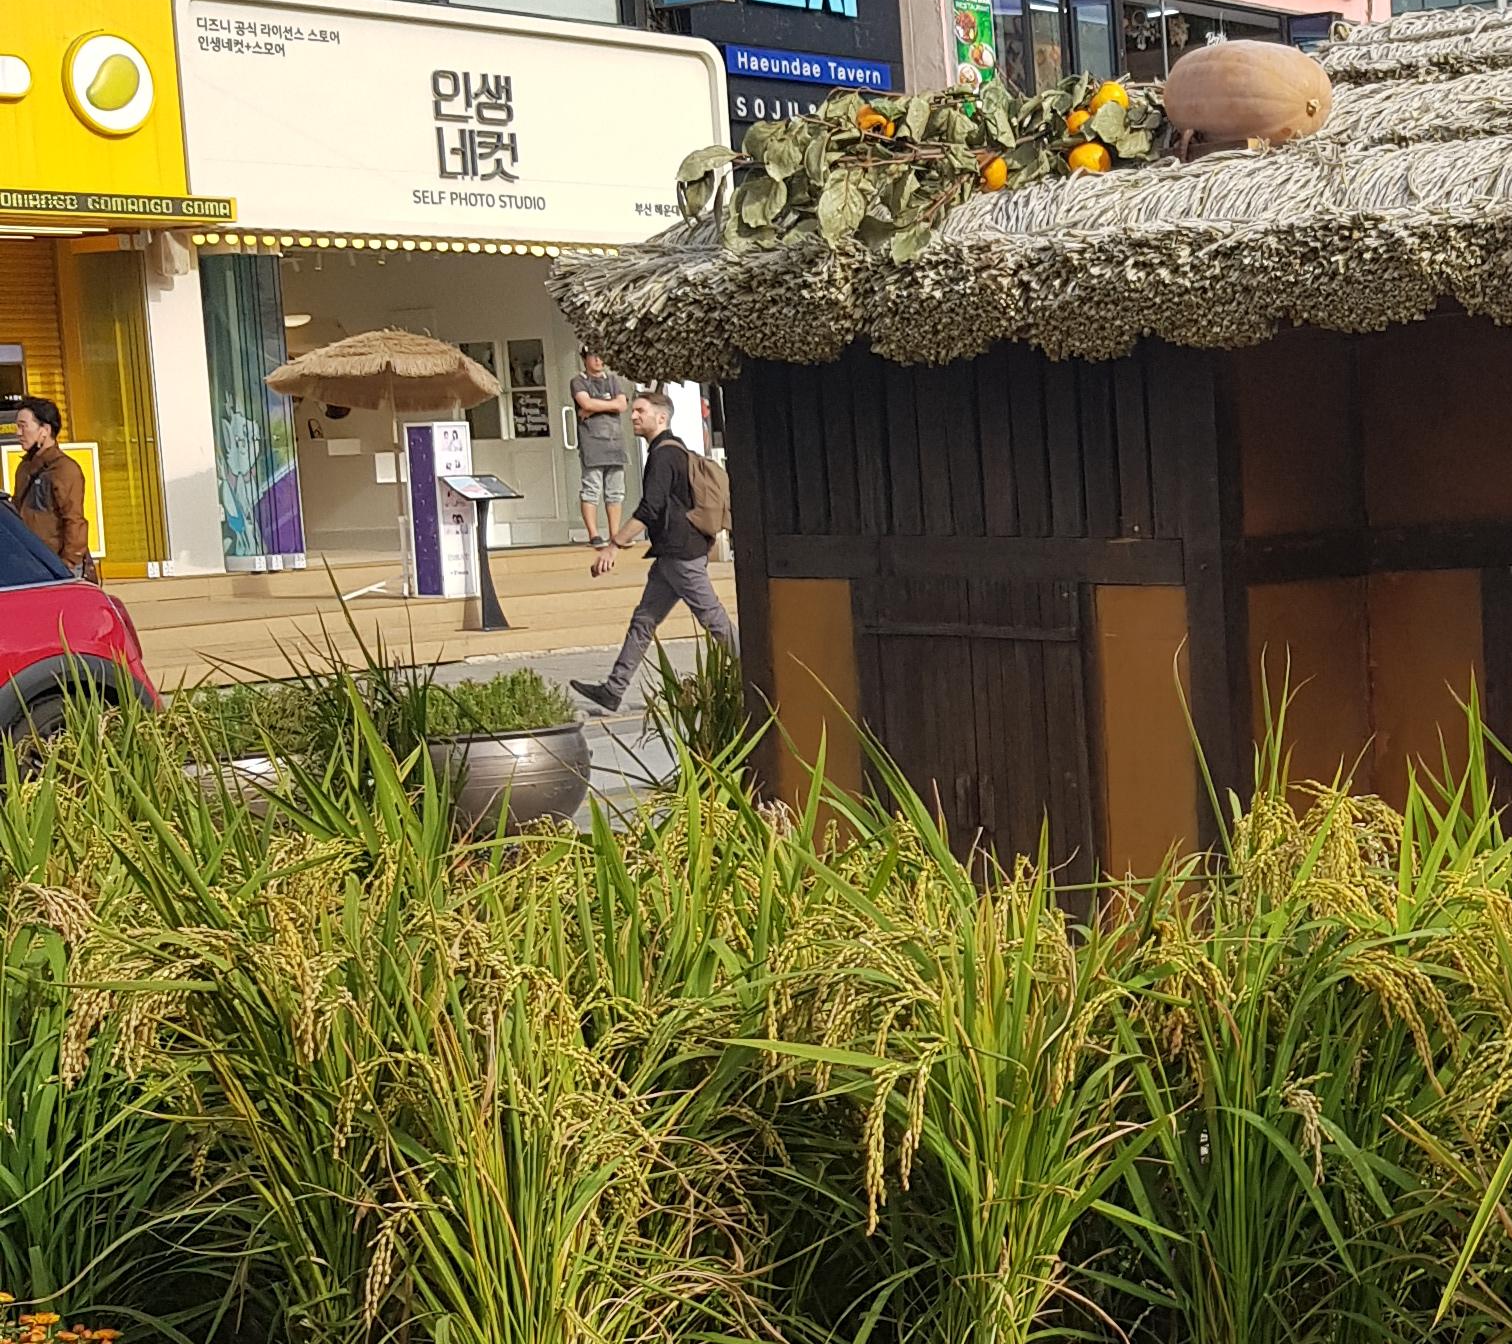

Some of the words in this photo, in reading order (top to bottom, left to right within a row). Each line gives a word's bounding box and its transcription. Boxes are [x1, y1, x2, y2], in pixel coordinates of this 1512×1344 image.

[195, 16, 231, 34] 디즈니
[234, 20, 257, 38] 공식
[260, 24, 305, 42] 라이선스
[307, 29, 341, 45] 스토어
[737, 51, 822, 78] Haeundae
[827, 61, 882, 85] Tavern
[431, 68, 515, 127] 인생
[736, 96, 799, 121] SOJU
[434, 125, 520, 184] 네컷
[87, 195, 173, 215] GOMANGO
[181, 200, 231, 217] GOMA
[412, 189, 446, 206] SELF
[450, 191, 496, 209] PHOTO
[498, 194, 547, 211] STUDIO
[634, 202, 653, 217] 부산
